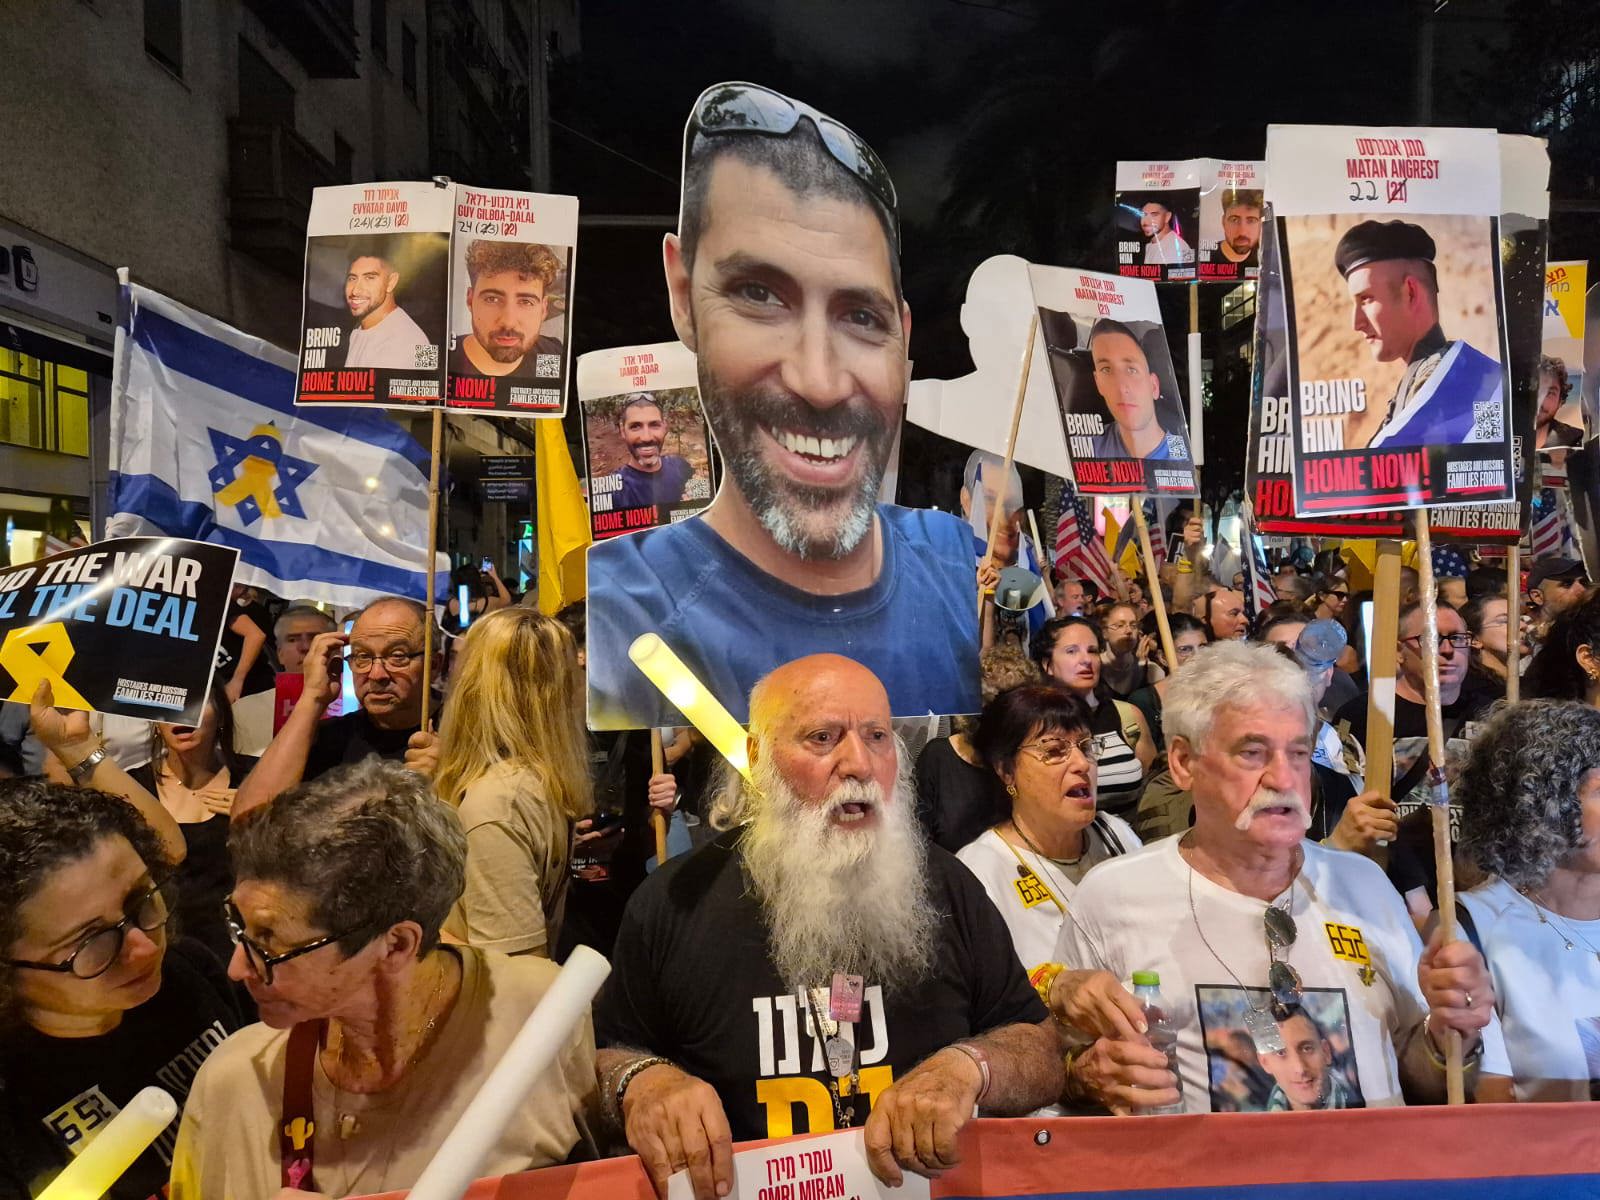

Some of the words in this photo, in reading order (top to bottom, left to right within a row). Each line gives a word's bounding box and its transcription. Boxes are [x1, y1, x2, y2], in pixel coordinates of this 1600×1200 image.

[1346, 159, 1388, 179] MATAN
[1391, 159, 1440, 179] ANGREST
[1349, 180, 1379, 202] 22
[353, 203, 384, 215] EVYATAR
[386, 201, 408, 213] DAVID
[457, 205, 475, 218] GUY
[476, 207, 536, 224] GILBOA-DALAL
[458, 221, 473, 233] 24
[1118, 241, 1141, 253] BRING
[1120, 265, 1140, 277] HOME
[1199, 264, 1215, 275] OME
[1546, 267, 1567, 285] מצ
[1075, 288, 1098, 300] MATAN
[1545, 300, 1560, 317] א
[306, 327, 341, 348] BRING
[303, 348, 327, 369] HIM
[640, 363, 659, 375] ADAR
[302, 371, 335, 392] HOME
[337, 368, 376, 392] NOW!
[455, 377, 496, 401] NOW!
[632, 375, 647, 387] (38)
[388, 386, 417, 397] FAMILIES
[418, 386, 440, 397] FORUM
[510, 393, 537, 404] FAMILIES
[538, 394, 561, 405] FORUM
[1300, 378, 1366, 416] BRING
[1065, 413, 1104, 436] BRING
[1260, 396, 1292, 434] BR
[1302, 417, 1345, 454] HIM
[1070, 436, 1095, 458] HIM
[1075, 461, 1109, 483] HOME
[1112, 461, 1145, 483] NOW!
[1303, 456, 1367, 494] HOME
[1371, 447, 1431, 490] NOW!
[1447, 471, 1479, 489] FAMILIES
[1479, 470, 1505, 487] FORUM
[591, 473, 623, 495] BRING
[592, 493, 614, 512] HIM
[1255, 479, 1294, 516] HO
[593, 510, 624, 531] HOME
[625, 505, 659, 528] NOW!
[1430, 509, 1480, 529] FAMILIES
[1481, 512, 1521, 531] FORUM
[37, 552, 108, 586] THE
[112, 551, 202, 598] WAR
[28, 584, 98, 623] THE
[105, 587, 200, 642] DEAL
[114, 687, 155, 703] FAMILIES
[155, 692, 186, 706] FORUM
[117, 678, 149, 691] HOSTAGES
[149, 681, 162, 693] AND
[162, 683, 188, 696] MISSING
[1325, 923, 1367, 959] 652
[766, 1156, 796, 1185] מירן
[798, 1149, 833, 1176] עמרי
[799, 1174, 845, 1200] MIRAN
